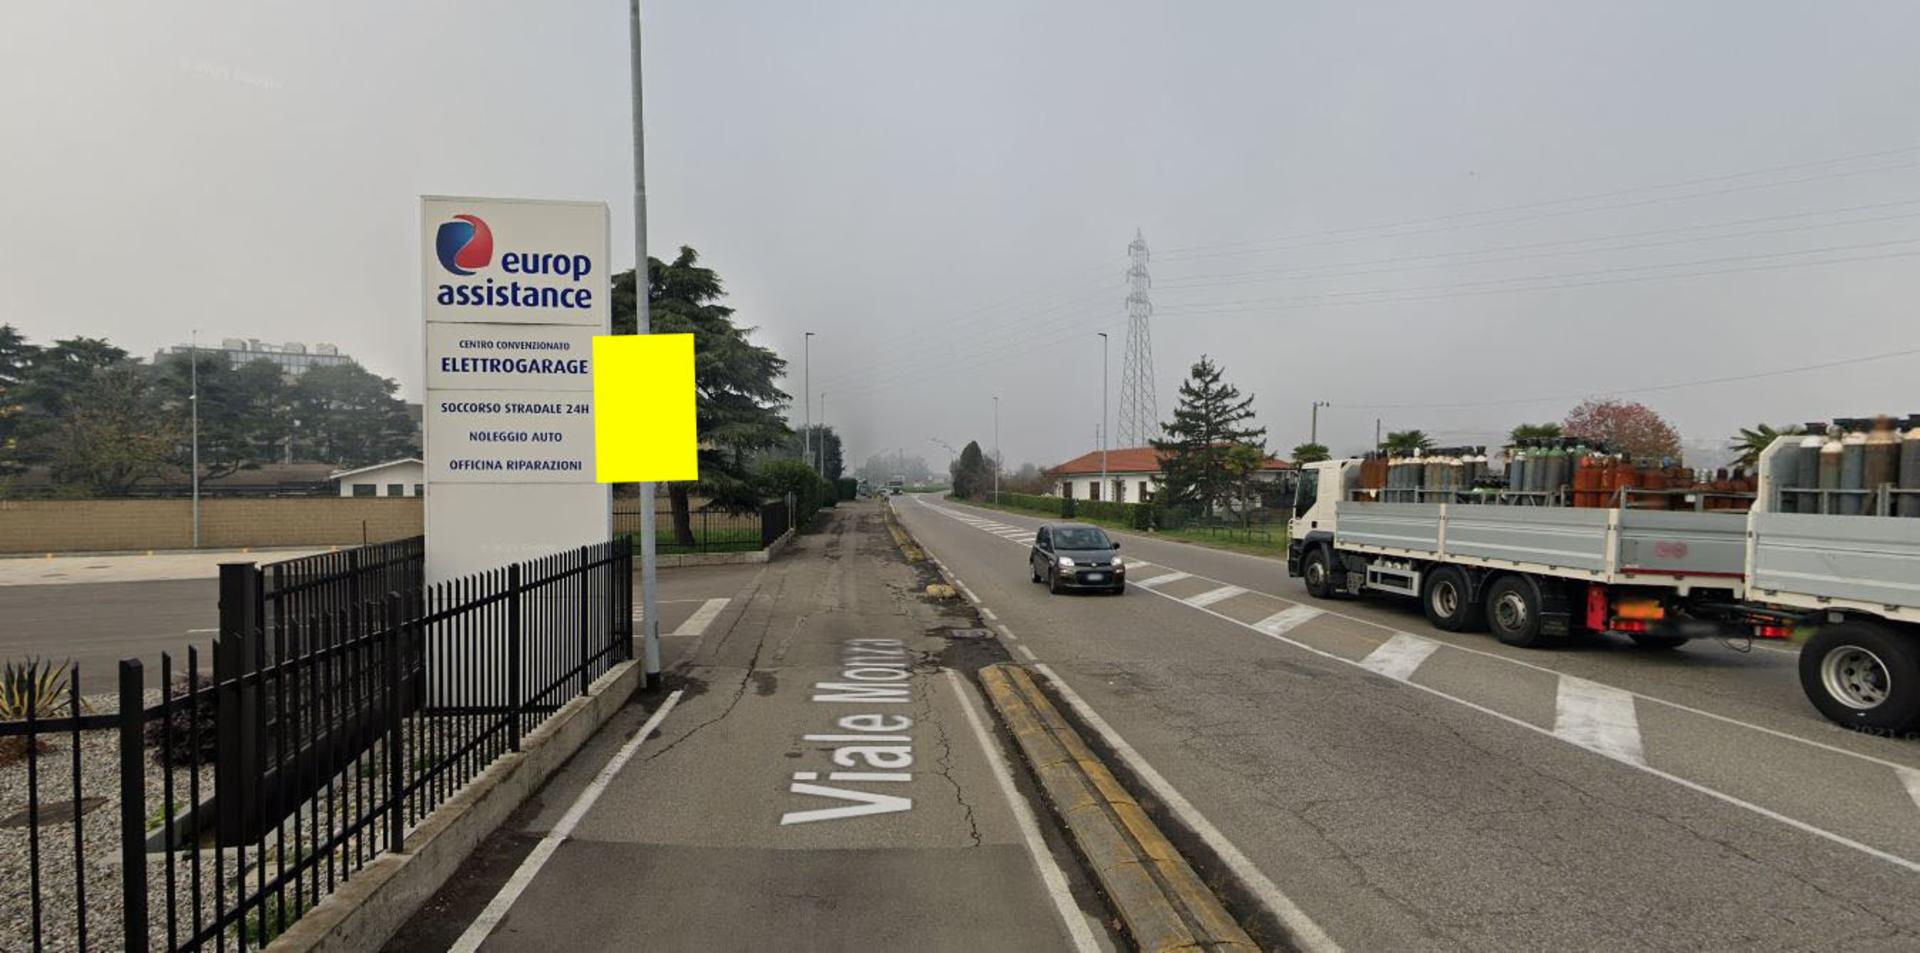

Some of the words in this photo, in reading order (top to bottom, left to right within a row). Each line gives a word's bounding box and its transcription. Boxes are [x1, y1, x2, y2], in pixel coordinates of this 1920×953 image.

[501, 251, 592, 282] europ
[437, 278, 592, 309] assistance
[459, 339, 494, 349] CENTRO
[496, 340, 571, 351] CONVENZIONATO
[441, 357, 589, 374] ELETTROGARAGE
[441, 402, 501, 413] SOCCORSO
[505, 403, 562, 414] STRADALE
[566, 404, 590, 414] 24H
[469, 431, 528, 442] NOLEGGIO
[531, 432, 563, 443] AUTO
[449, 459, 503, 470] OFFICINA
[506, 459, 582, 471] RIPARAZIONI
